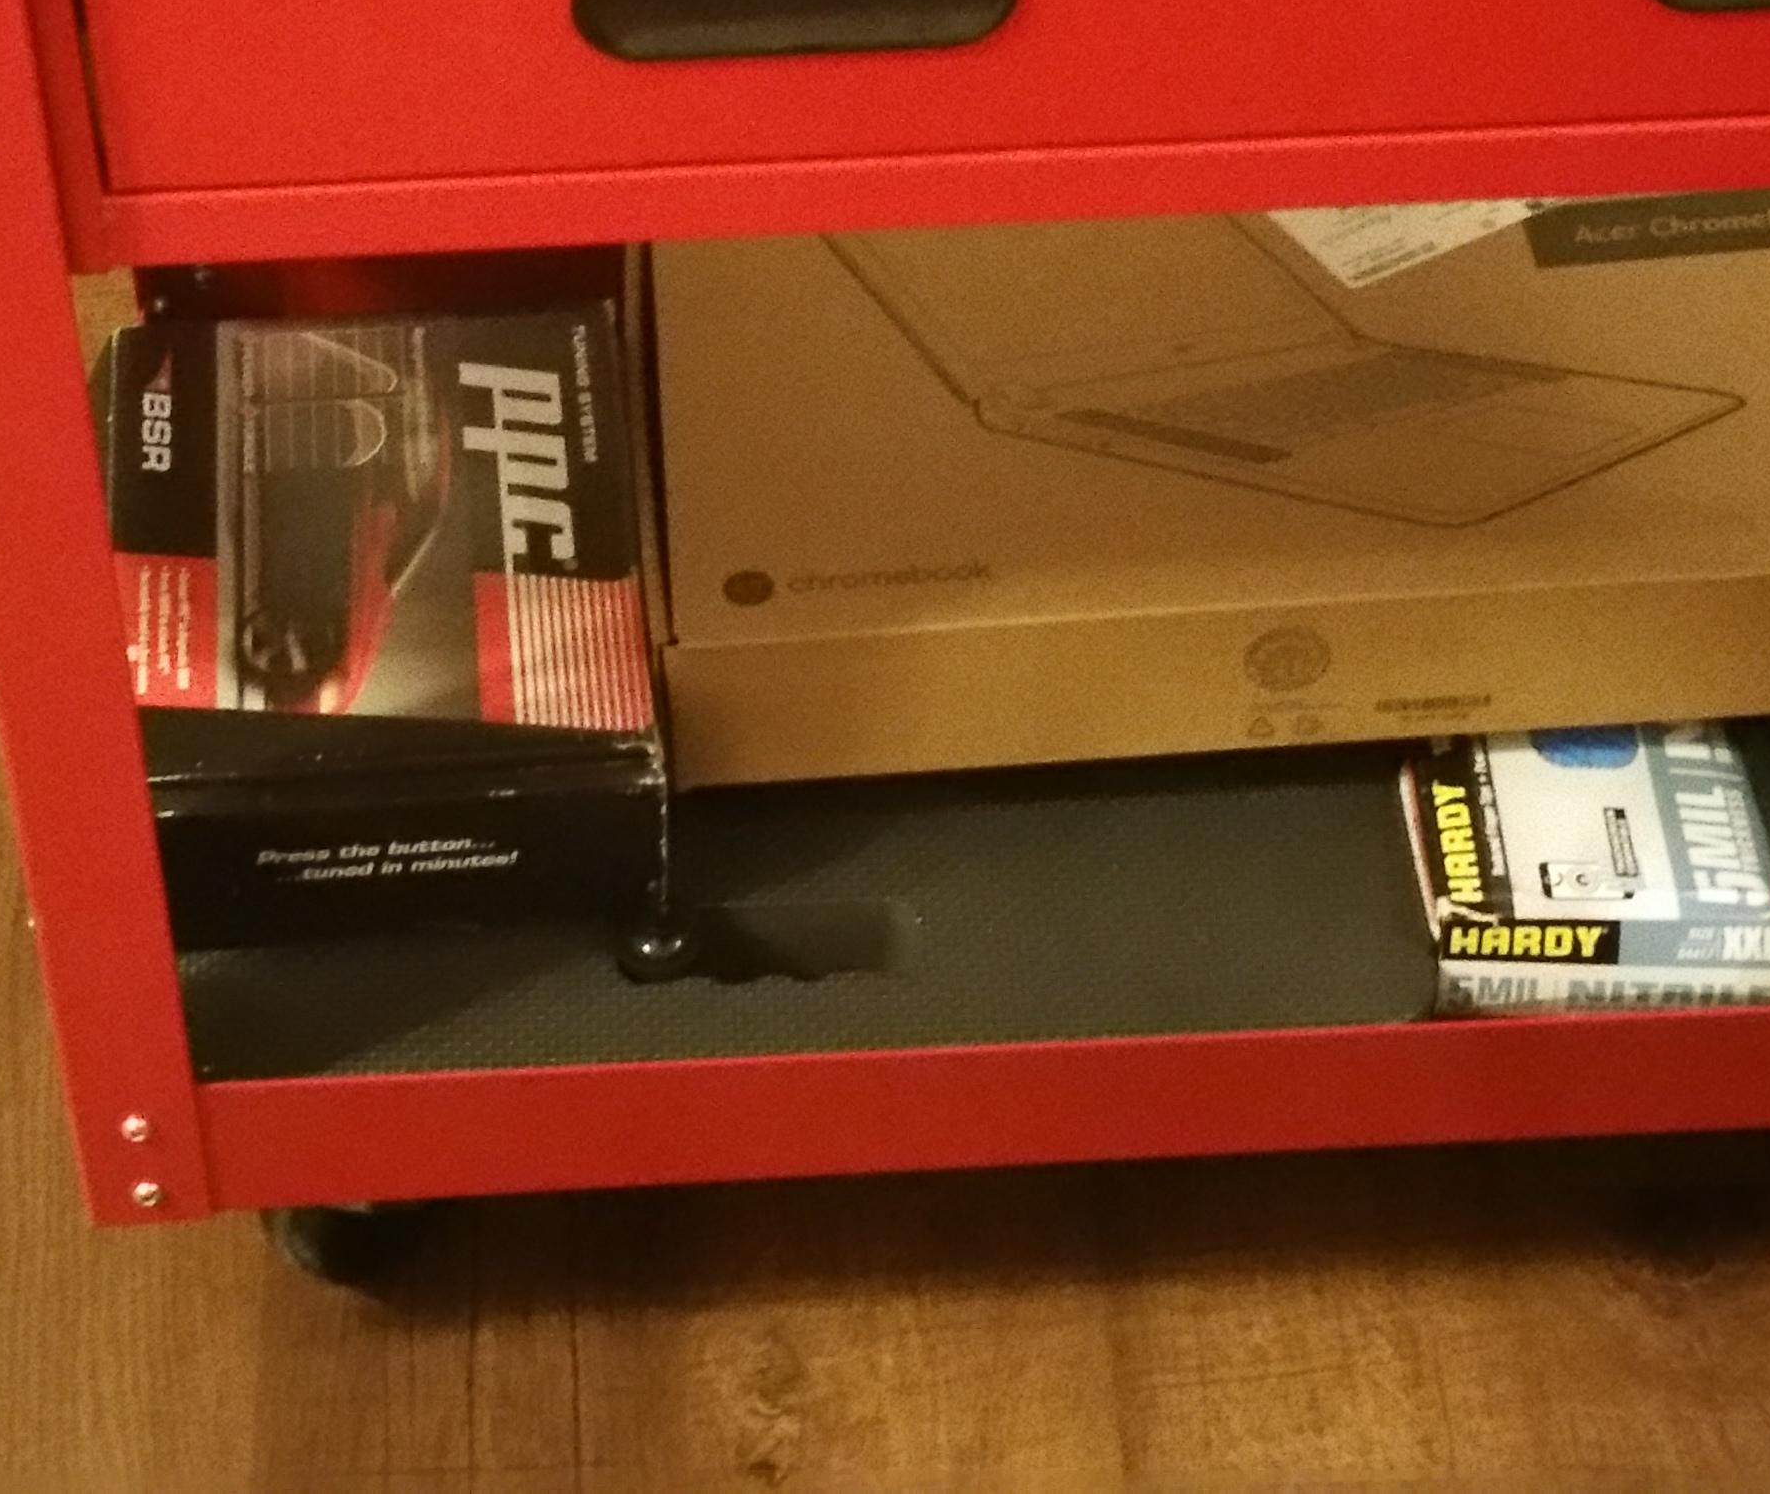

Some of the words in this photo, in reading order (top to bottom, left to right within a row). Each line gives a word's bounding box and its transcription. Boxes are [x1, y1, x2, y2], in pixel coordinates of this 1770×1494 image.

[1575, 223, 1636, 244] Acer
[141, 392, 172, 472] BSR
[786, 561, 992, 593] chromebook
[257, 849, 330, 865] Press
[339, 844, 381, 859] the
[1432, 784, 1484, 903] HARDY
[1675, 786, 1770, 907] 5MIL
[381, 860, 403, 874] in
[410, 850, 519, 873] minutes!
[1449, 925, 1601, 958] HARDY
